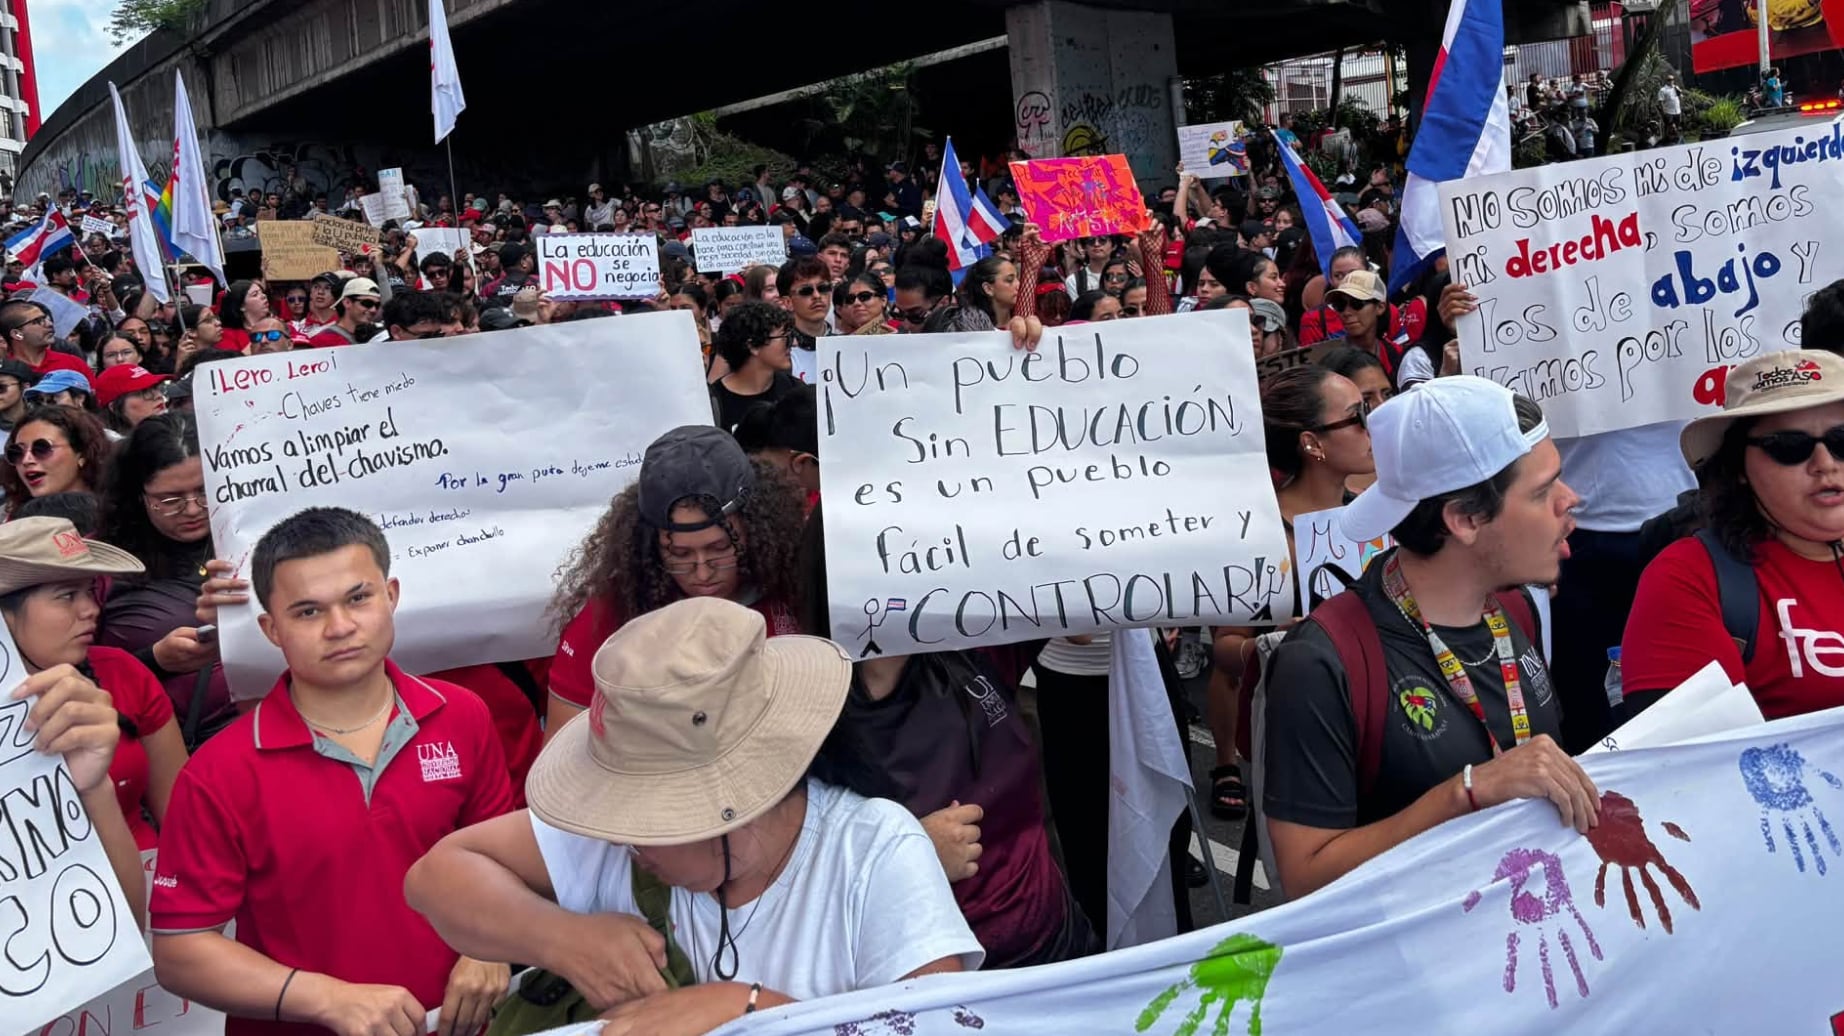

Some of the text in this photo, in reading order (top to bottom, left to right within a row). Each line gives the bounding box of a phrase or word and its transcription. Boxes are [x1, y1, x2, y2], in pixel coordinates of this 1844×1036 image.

[1452, 191, 1501, 239] NO
[1633, 157, 1669, 198] ni
[1672, 147, 1722, 192] de
[1731, 122, 1844, 189] izquierd
[542, 238, 651, 259] La educación
[1456, 245, 1496, 289] ni
[1505, 212, 1659, 278] derecha,
[545, 258, 598, 292] NO
[612, 259, 630, 270] se
[605, 266, 660, 290] negocia
[1573, 275, 1633, 333] de
[1651, 242, 1782, 317] abajo
[953, 333, 1139, 414] pueblo
[1616, 319, 1688, 402] por
[1703, 307, 1761, 364] los
[1755, 365, 1793, 381] Todos
[281, 372, 415, 422] Chaves tiene miedo
[1752, 374, 1790, 392] somos
[1791, 371, 1822, 382] ASO
[204, 441, 273, 472] Vamos
[379, 407, 400, 439] el
[300, 455, 340, 488] del
[348, 437, 449, 480] chavismo.
[893, 417, 971, 465] Sin
[435, 472, 467, 490] Por
[476, 471, 488, 487] la
[498, 472, 525, 493] gran
[854, 454, 1171, 506] es un pueblo
[876, 508, 1251, 575] fácil de someter y
[908, 557, 1266, 644] CONTROLAR!
[415, 740, 458, 761] UNA
